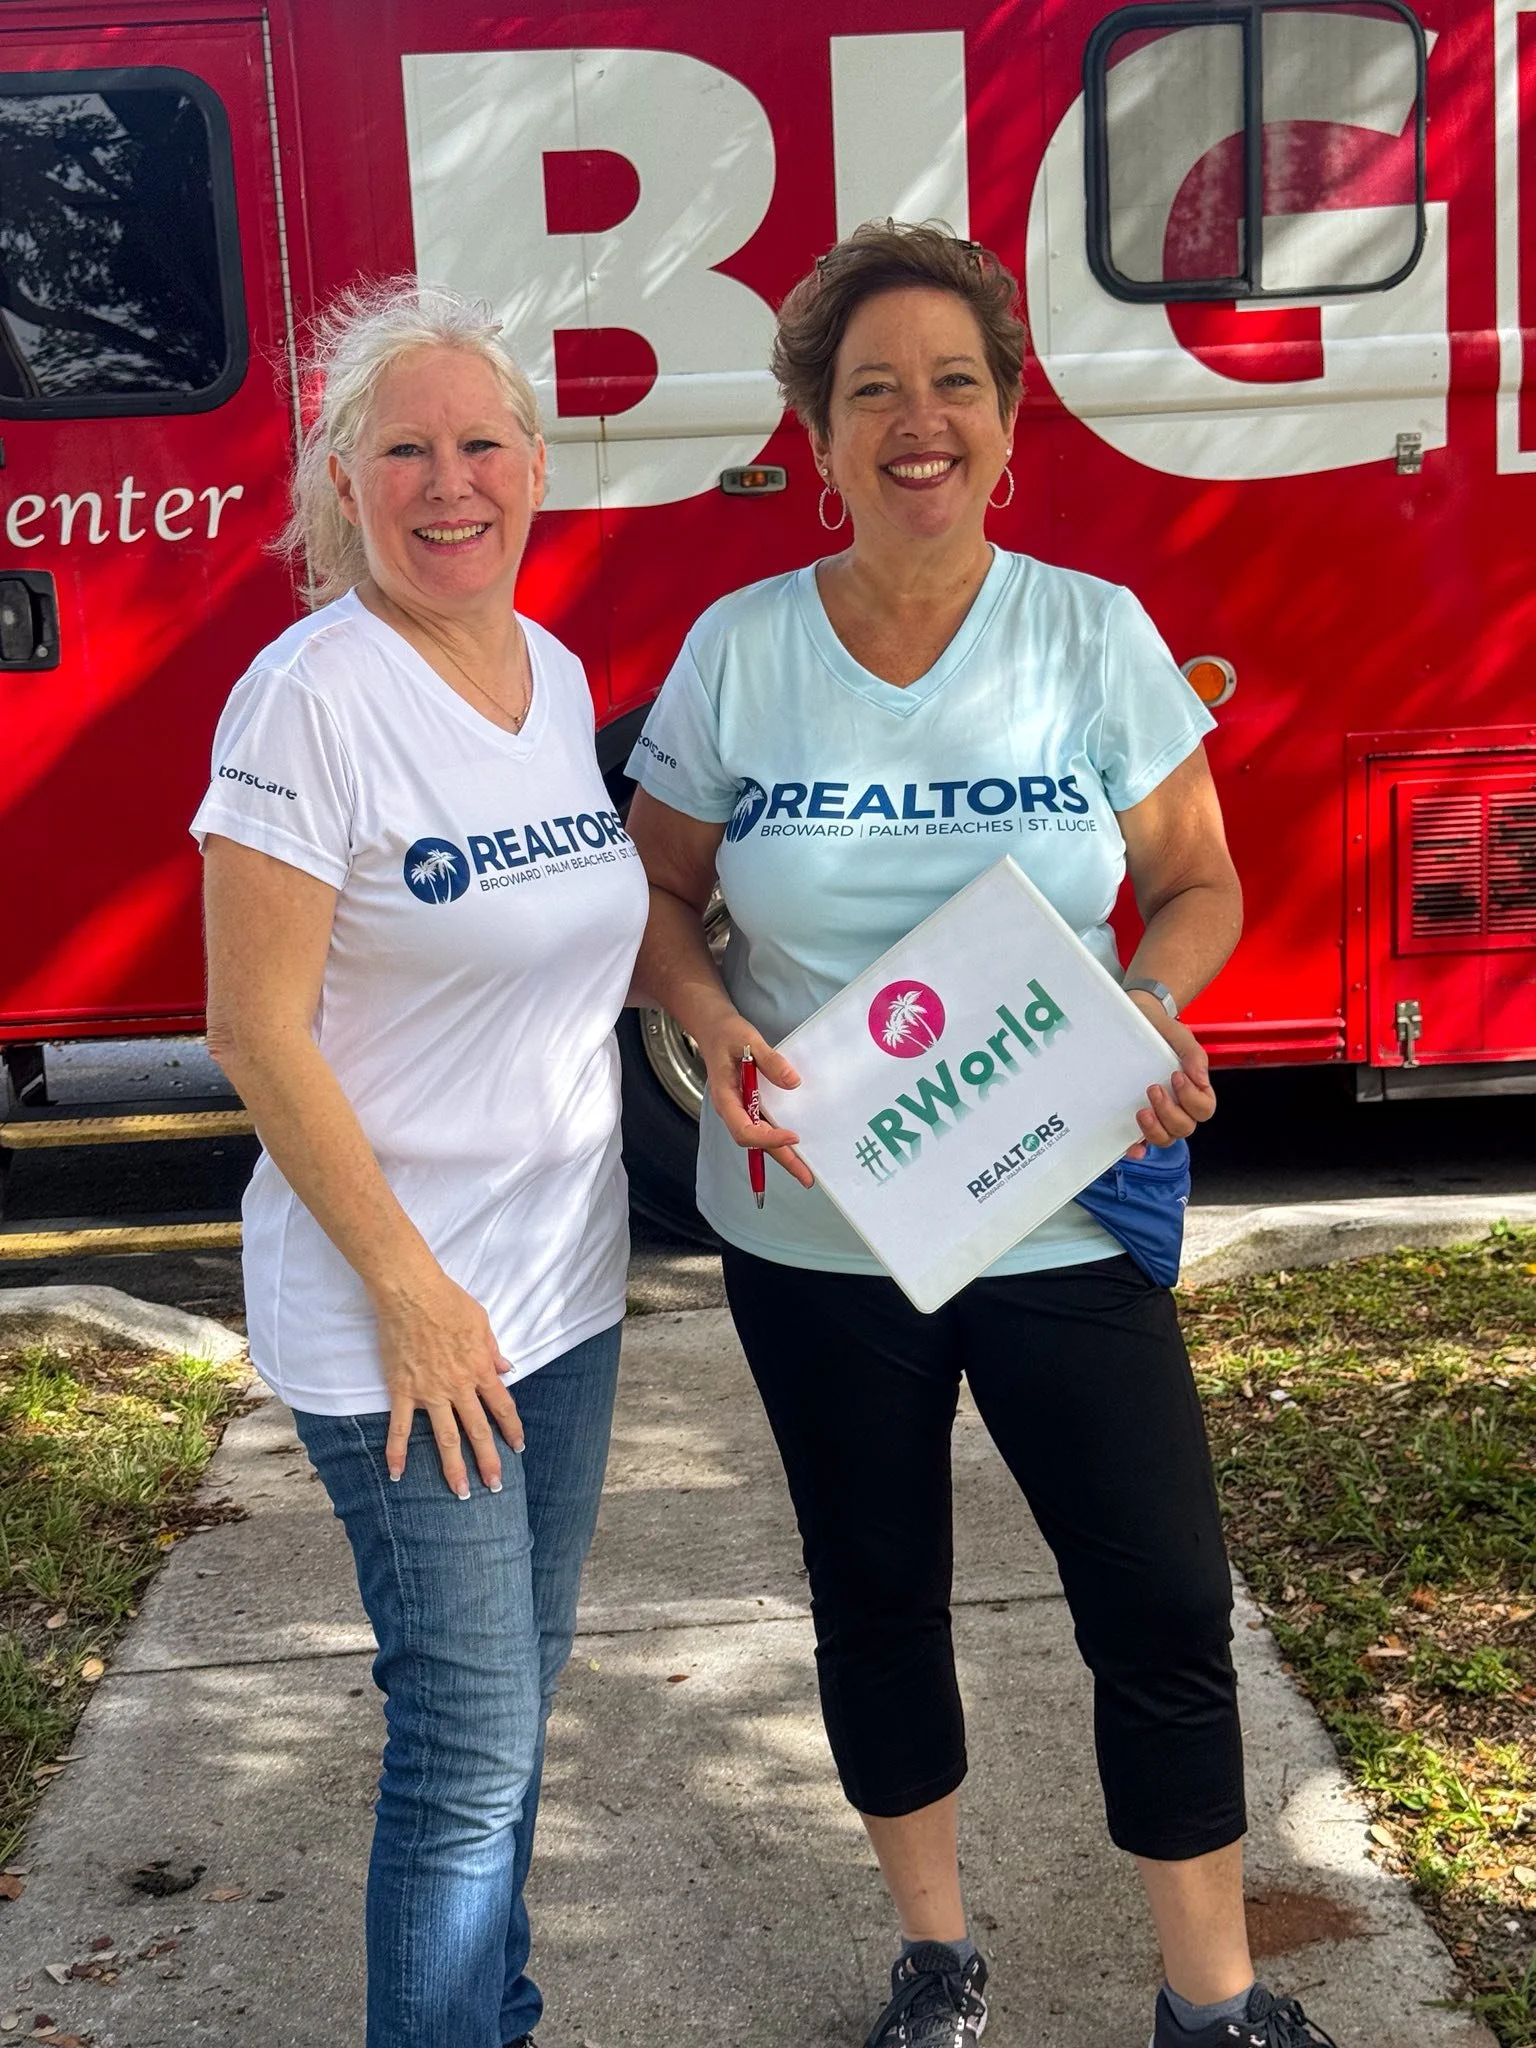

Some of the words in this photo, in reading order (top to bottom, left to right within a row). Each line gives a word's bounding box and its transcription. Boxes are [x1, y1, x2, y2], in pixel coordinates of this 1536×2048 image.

[6, 476, 244, 547] enter
[766, 775, 1089, 820] REALTORS
[760, 824, 854, 837] BROWARD
[869, 824, 918, 837] PALM
[926, 819, 1013, 835] BEACHES
[1028, 818, 1052, 831] ST.
[1057, 818, 1097, 832] LUCIE
[480, 868, 541, 892] BROWARD
[547, 860, 571, 875] PALM
[572, 851, 616, 870] BEACHES
[855, 978, 1065, 1178] #RWorld
[977, 1180, 1006, 1204] BROWARD
[1006, 1166, 1022, 1182] PALM
[1021, 1148, 1046, 1169] BEACHES
